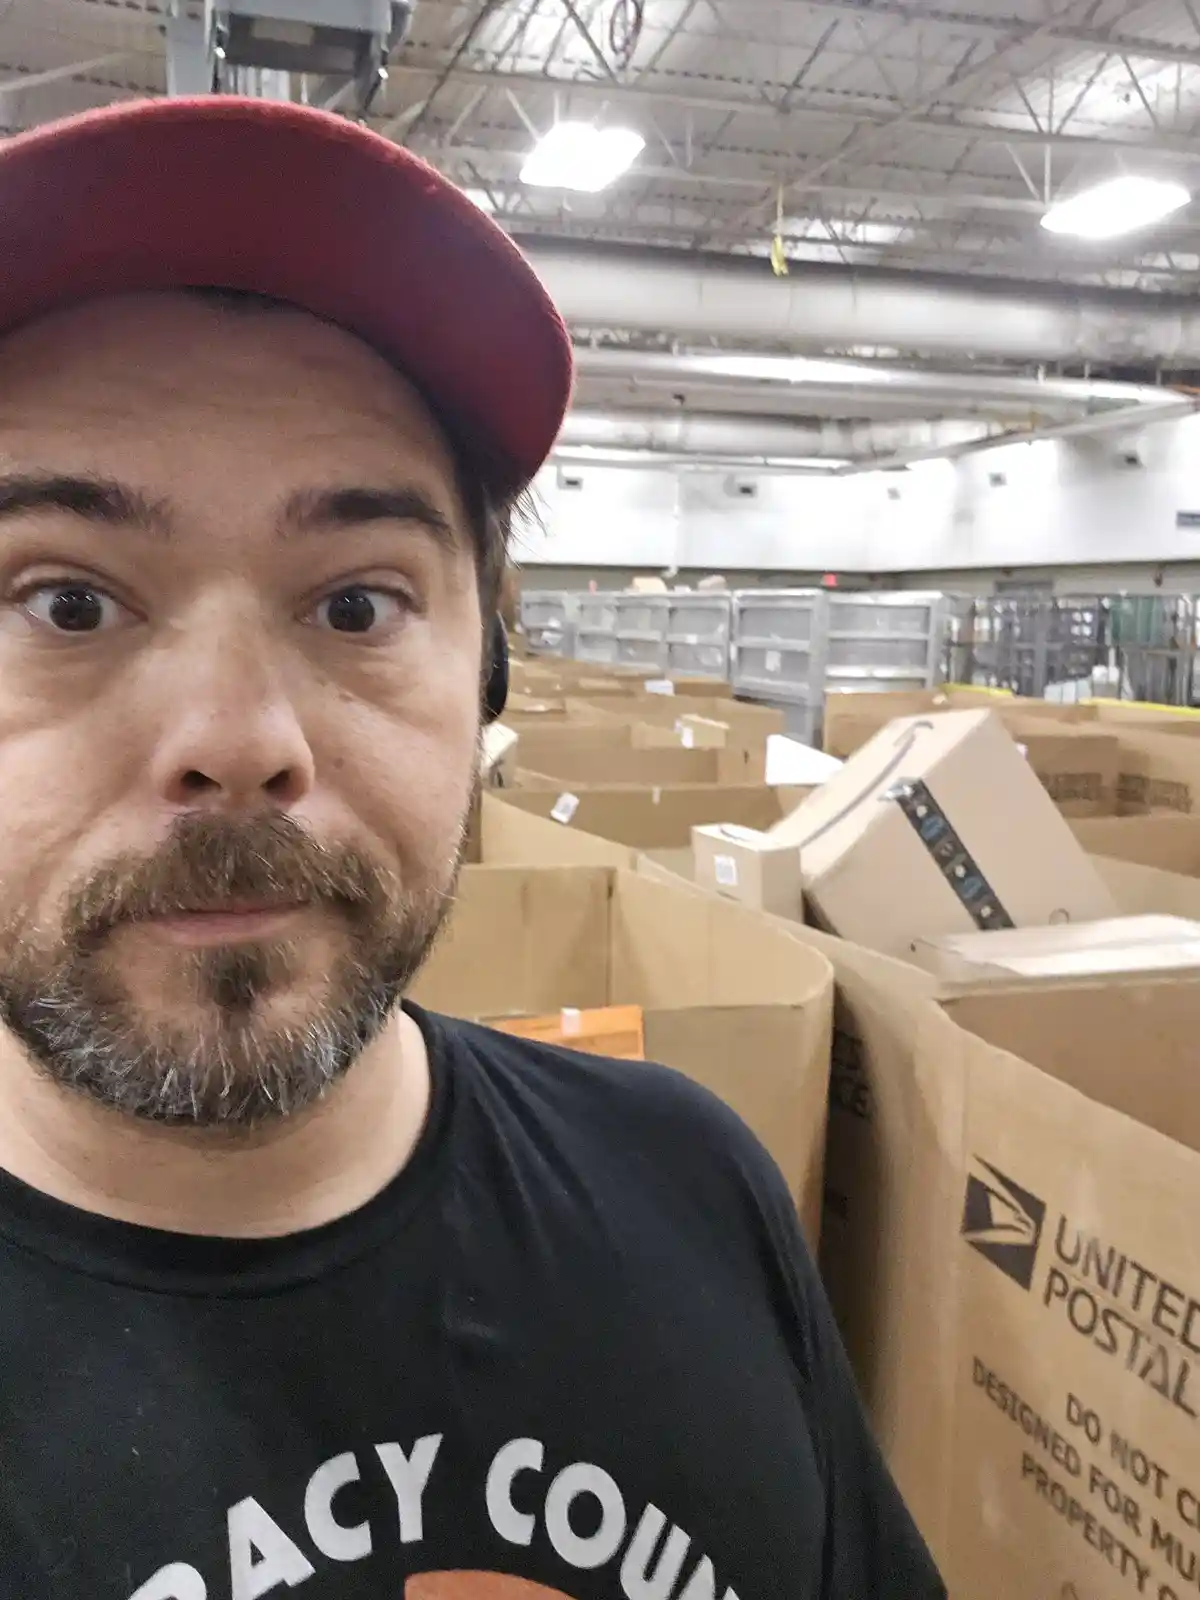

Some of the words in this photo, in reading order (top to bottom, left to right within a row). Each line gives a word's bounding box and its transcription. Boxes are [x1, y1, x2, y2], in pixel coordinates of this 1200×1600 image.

[1043, 1265, 1198, 1420] POSTAL
[972, 1355, 1081, 1478] DESIGNED
[1088, 1463, 1142, 1538] FOR
[1150, 1516, 1200, 1593] MU
[1020, 1449, 1150, 1594] PROPERTY
[1066, 1392, 1102, 1446] DO
[1109, 1428, 1170, 1500] NOT
[1176, 1487, 1200, 1534] C
